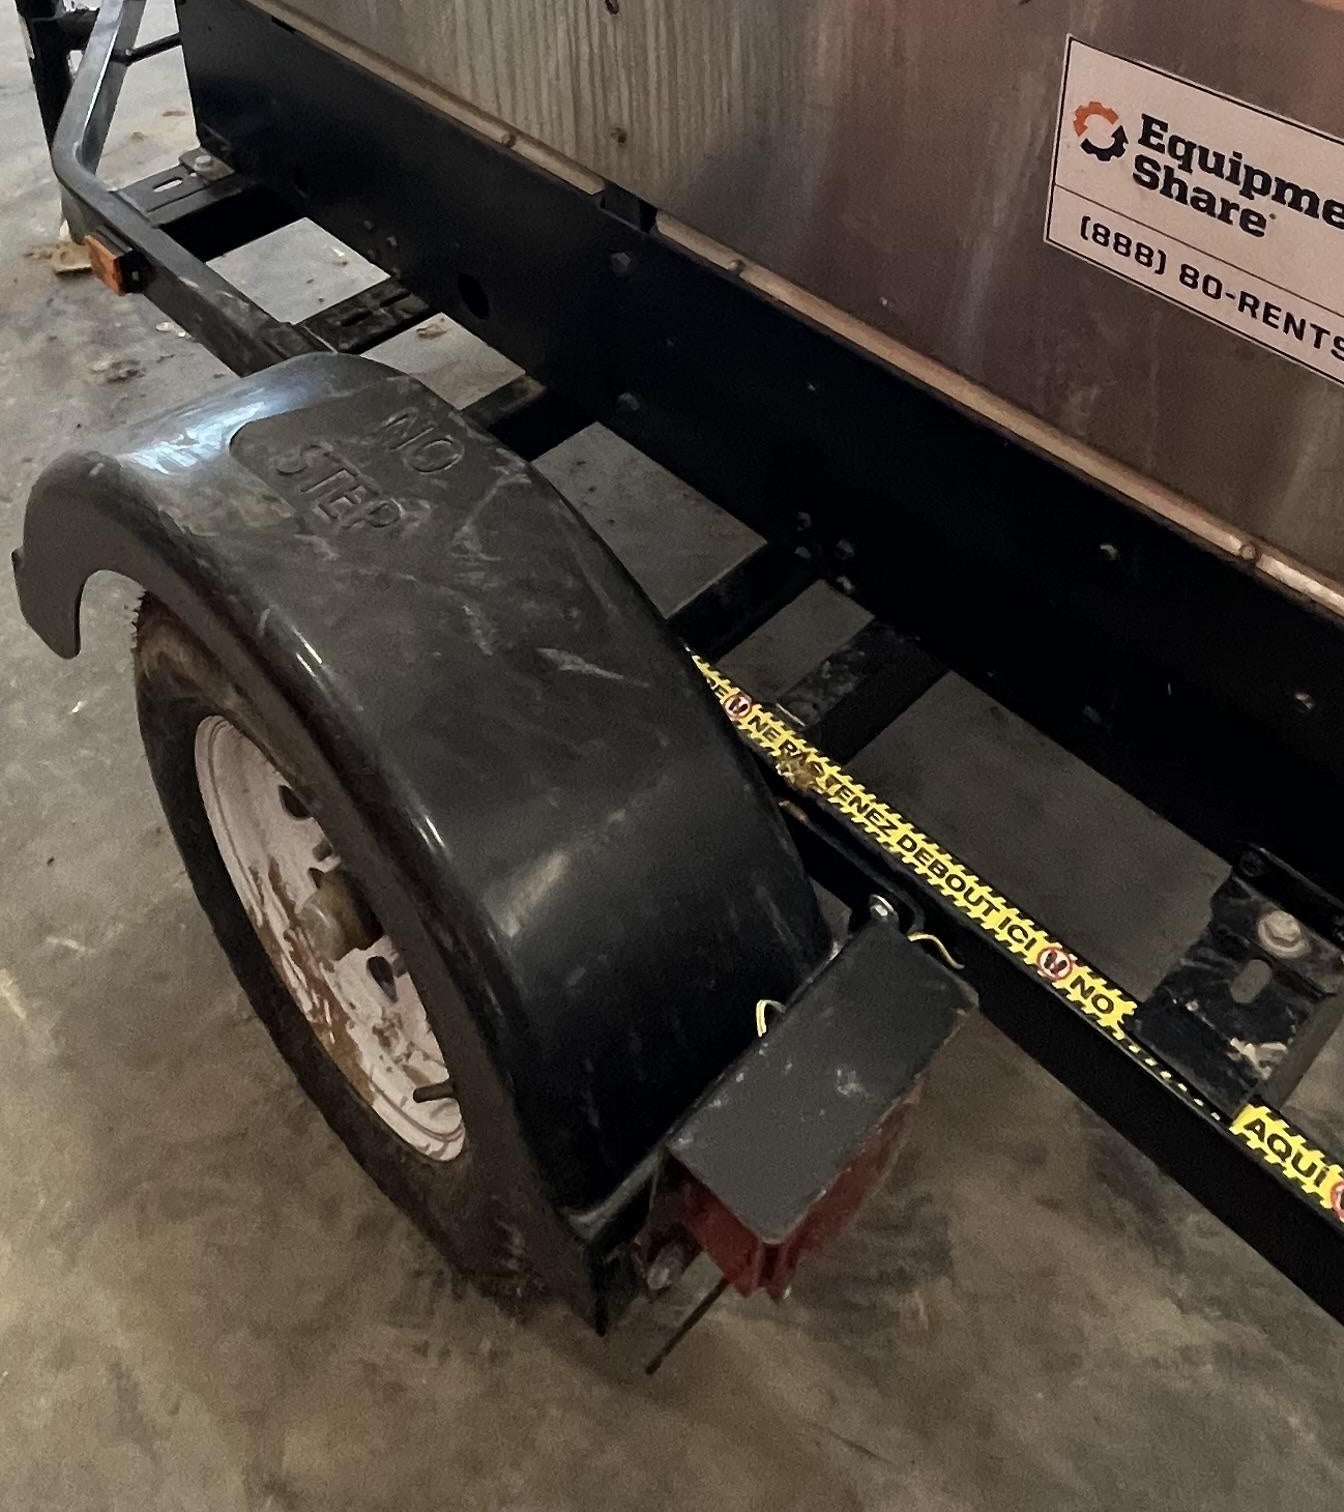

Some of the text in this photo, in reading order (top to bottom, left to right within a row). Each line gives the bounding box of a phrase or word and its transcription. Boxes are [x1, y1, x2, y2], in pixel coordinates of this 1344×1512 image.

[1131, 154, 1267, 238] Share
[1080, 215, 1167, 275] (888)
[747, 715, 781, 742] NE
[895, 833, 1001, 918] DEBOUT
[997, 916, 1038, 951] ICI
[1070, 975, 1115, 1015] NO
